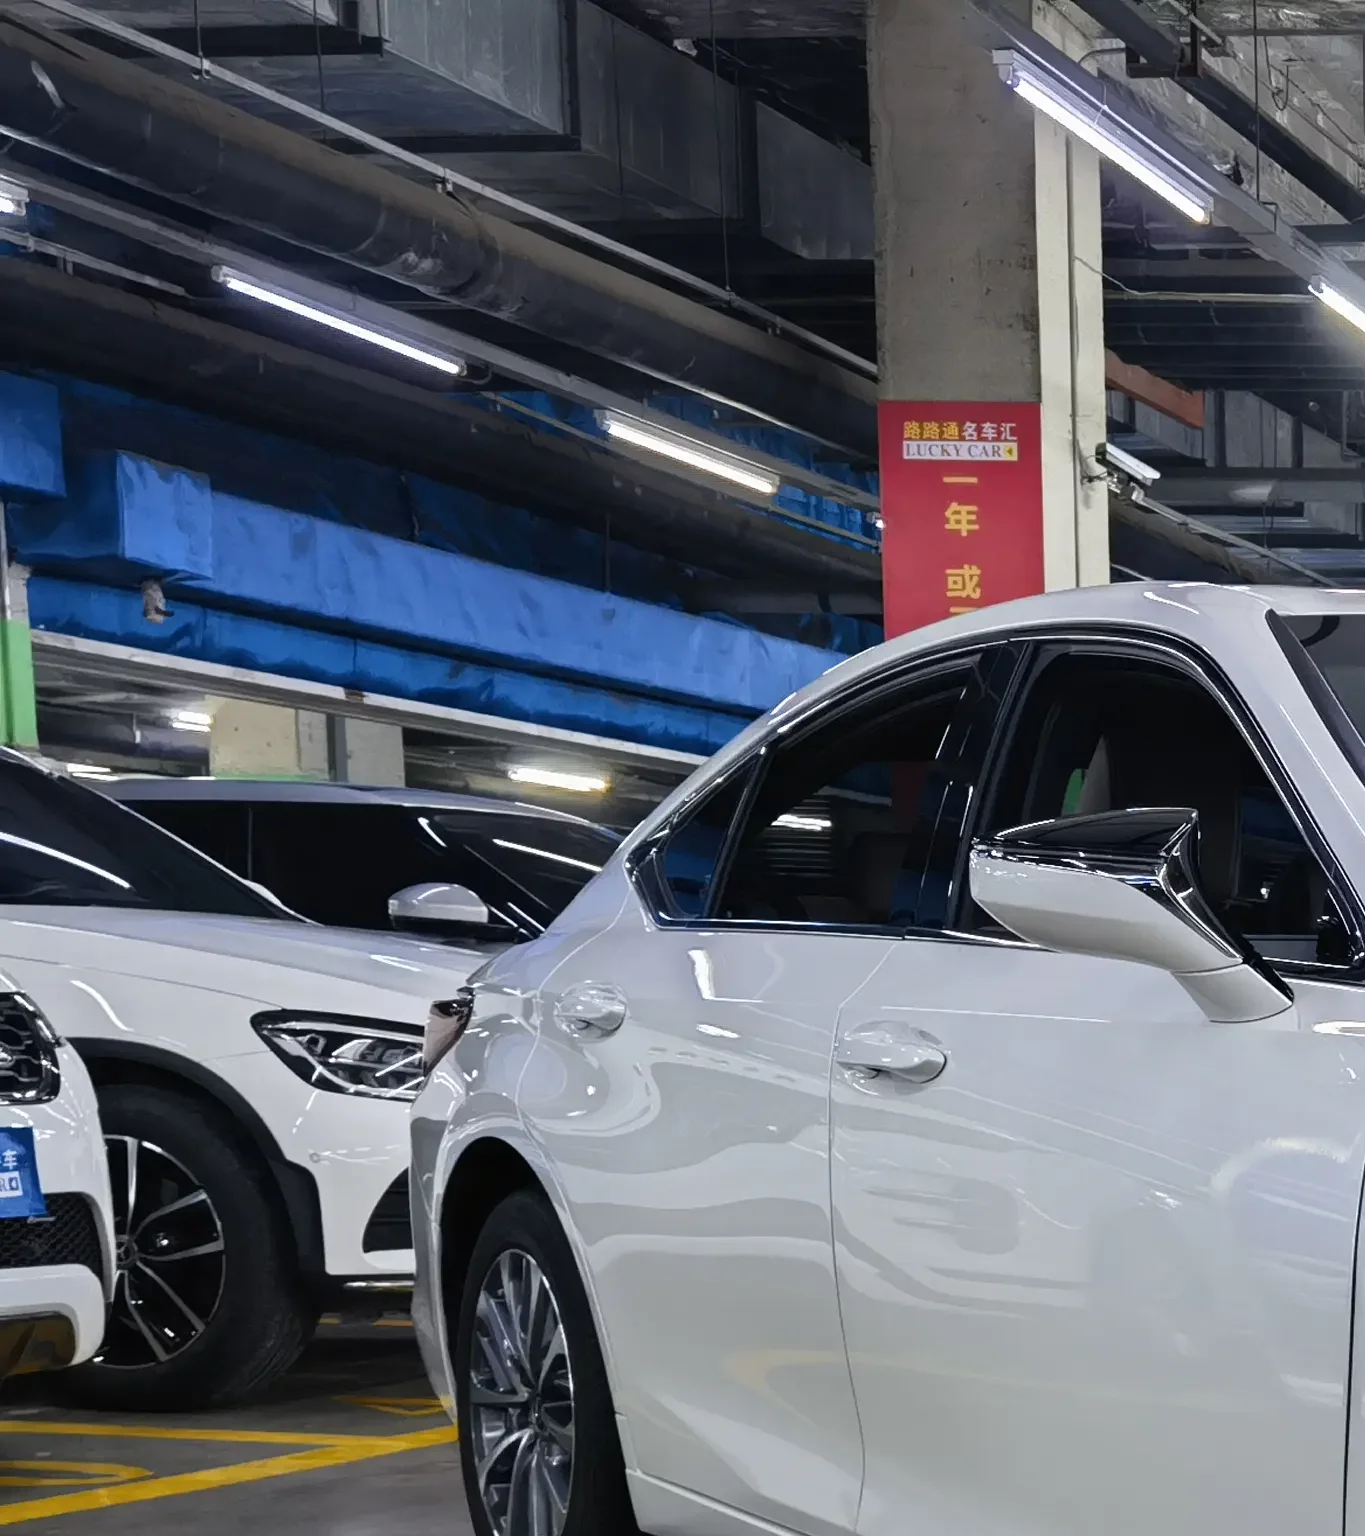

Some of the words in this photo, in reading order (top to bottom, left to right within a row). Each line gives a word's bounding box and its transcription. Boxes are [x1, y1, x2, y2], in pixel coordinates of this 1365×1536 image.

[903, 420, 1017, 440] 路路通名车汇
[905, 443, 964, 458] LUCKY
[967, 444, 1002, 459] CAR
